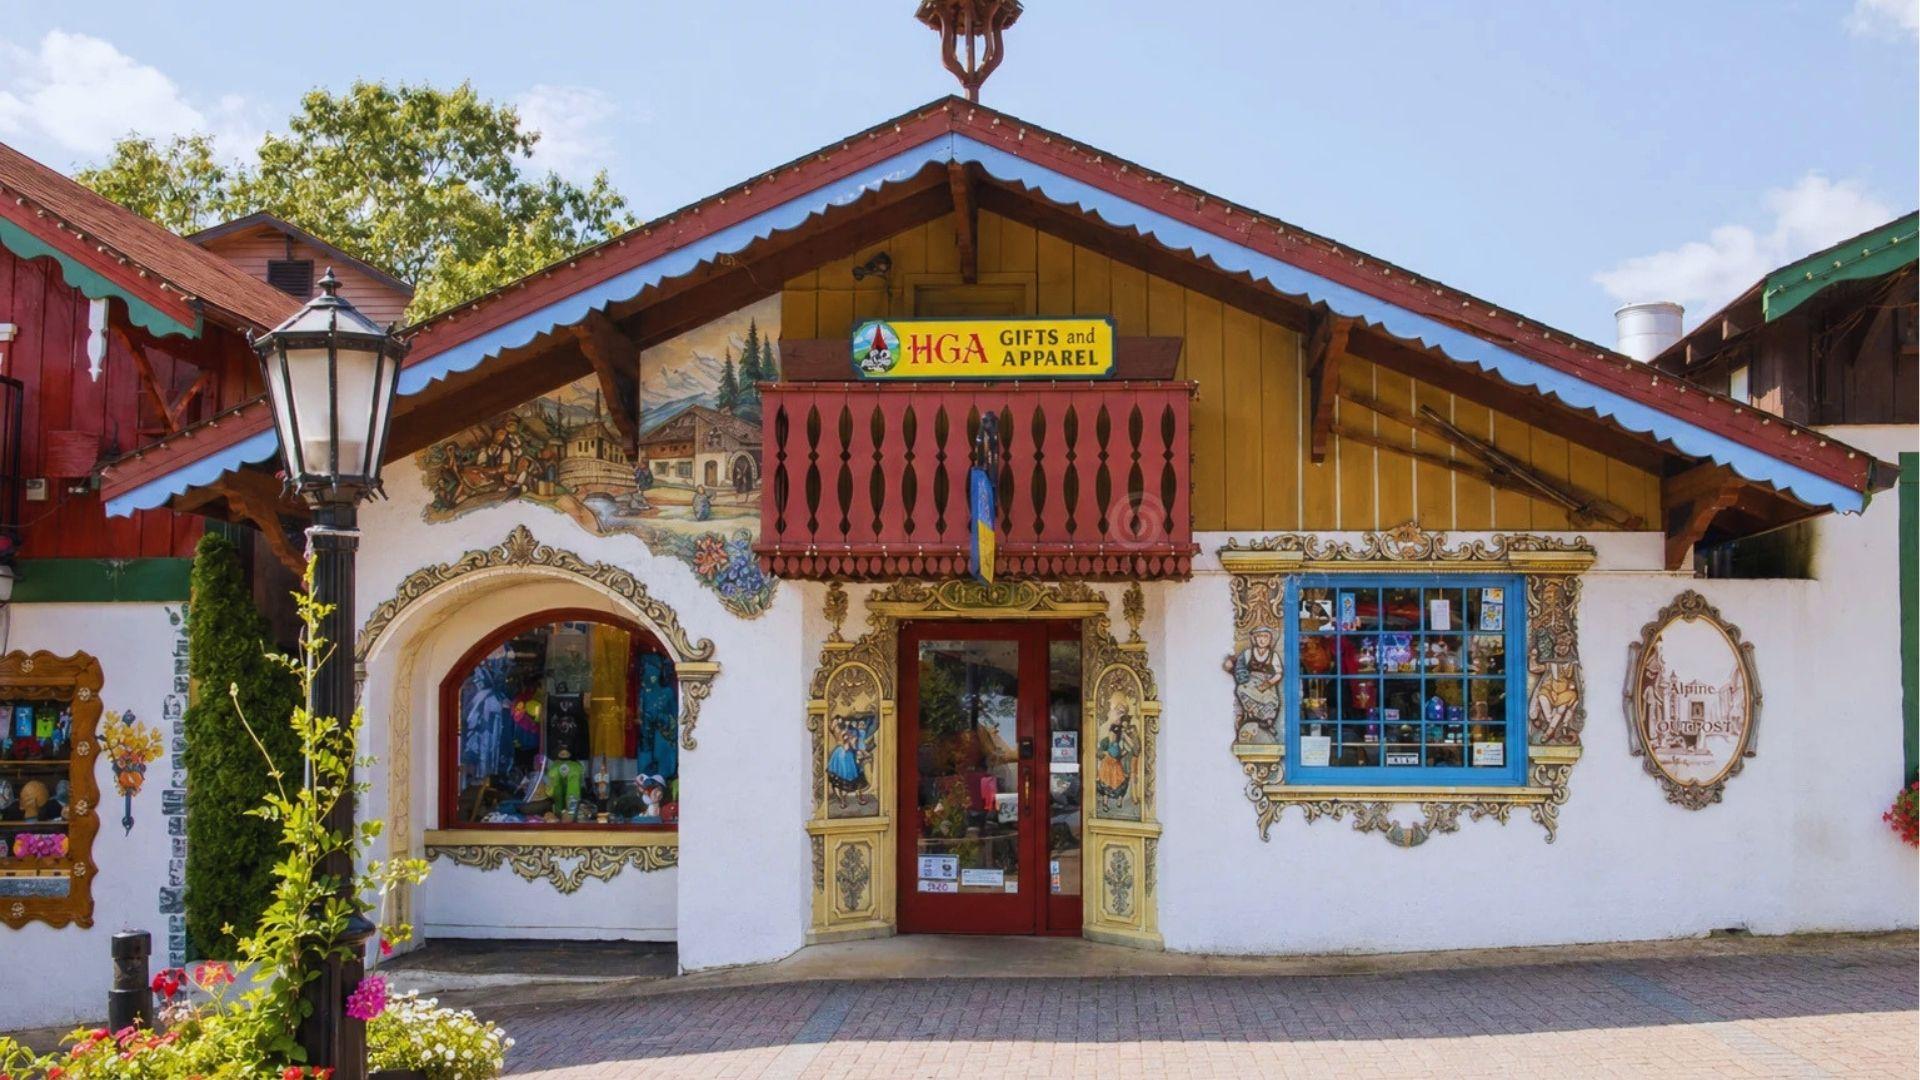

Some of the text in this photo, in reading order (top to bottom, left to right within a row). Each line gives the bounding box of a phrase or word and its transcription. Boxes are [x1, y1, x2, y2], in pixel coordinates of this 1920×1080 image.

[999, 327, 1096, 346] GIFTS and
[910, 333, 989, 364] HGA
[1001, 350, 1099, 367] APPAREL
[1671, 681, 1715, 697] Alpine
